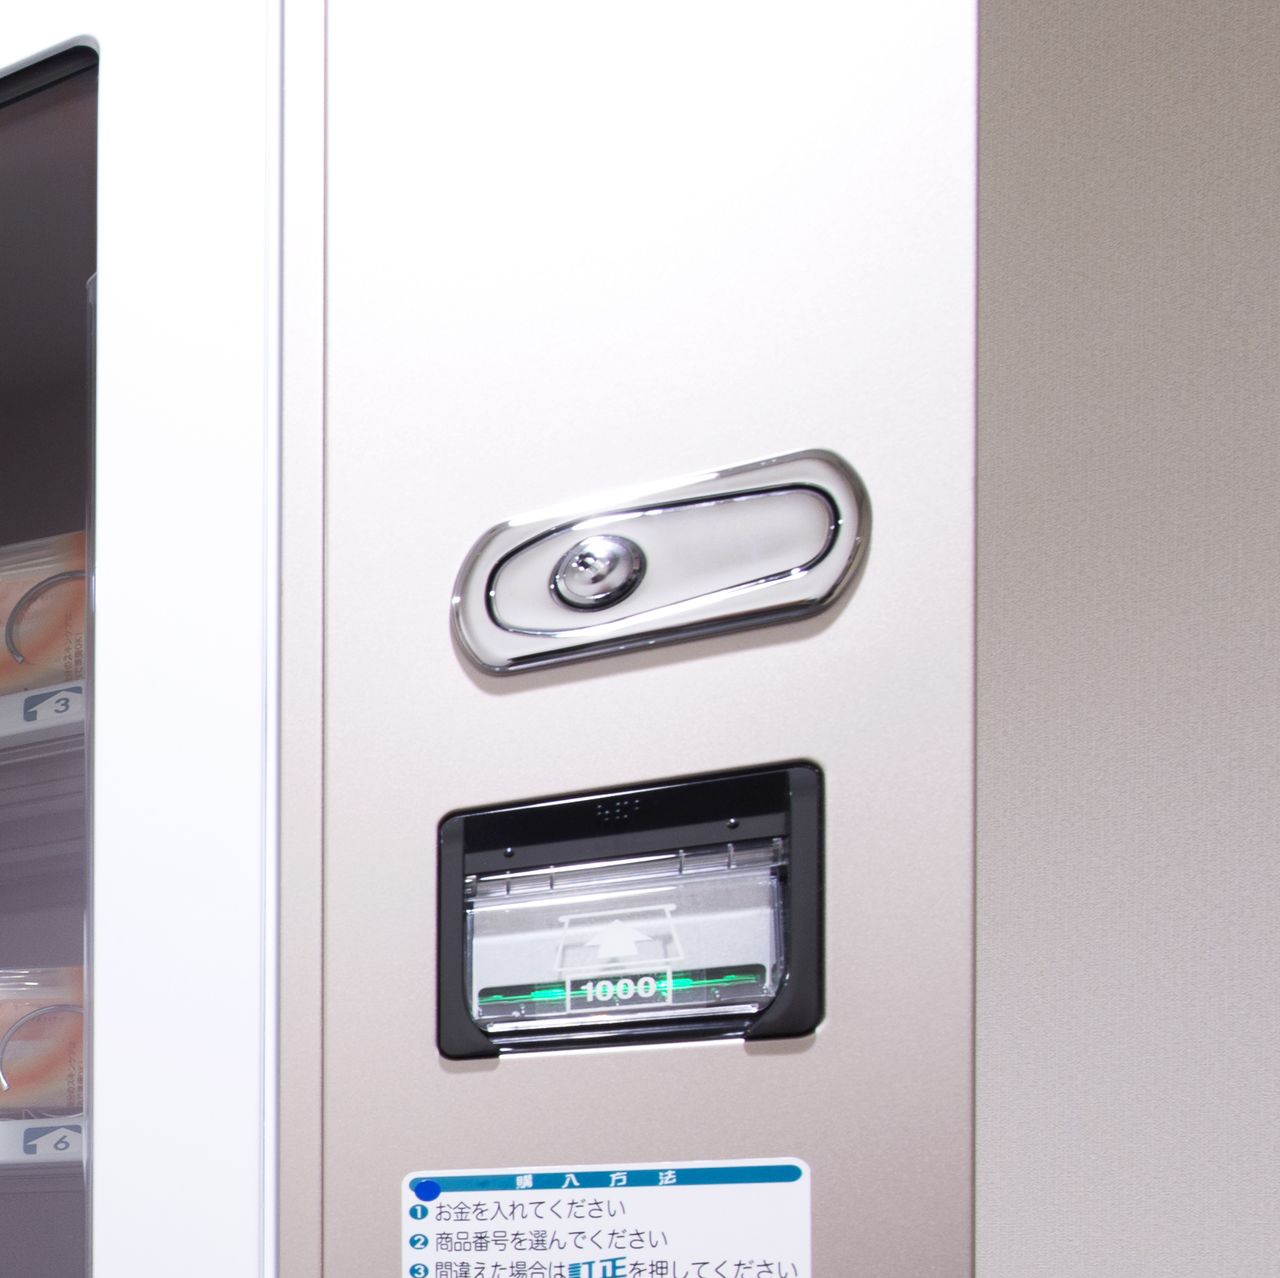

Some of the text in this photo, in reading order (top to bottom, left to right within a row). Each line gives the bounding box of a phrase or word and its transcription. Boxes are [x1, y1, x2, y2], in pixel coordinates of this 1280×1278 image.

[54, 698, 70, 714] 3
[580, 976, 658, 1002] 1000
[54, 1135, 70, 1151] 6
[435, 1198, 625, 1223] お金を入れてください
[435, 1228, 669, 1253] 商品番号を選んでください
